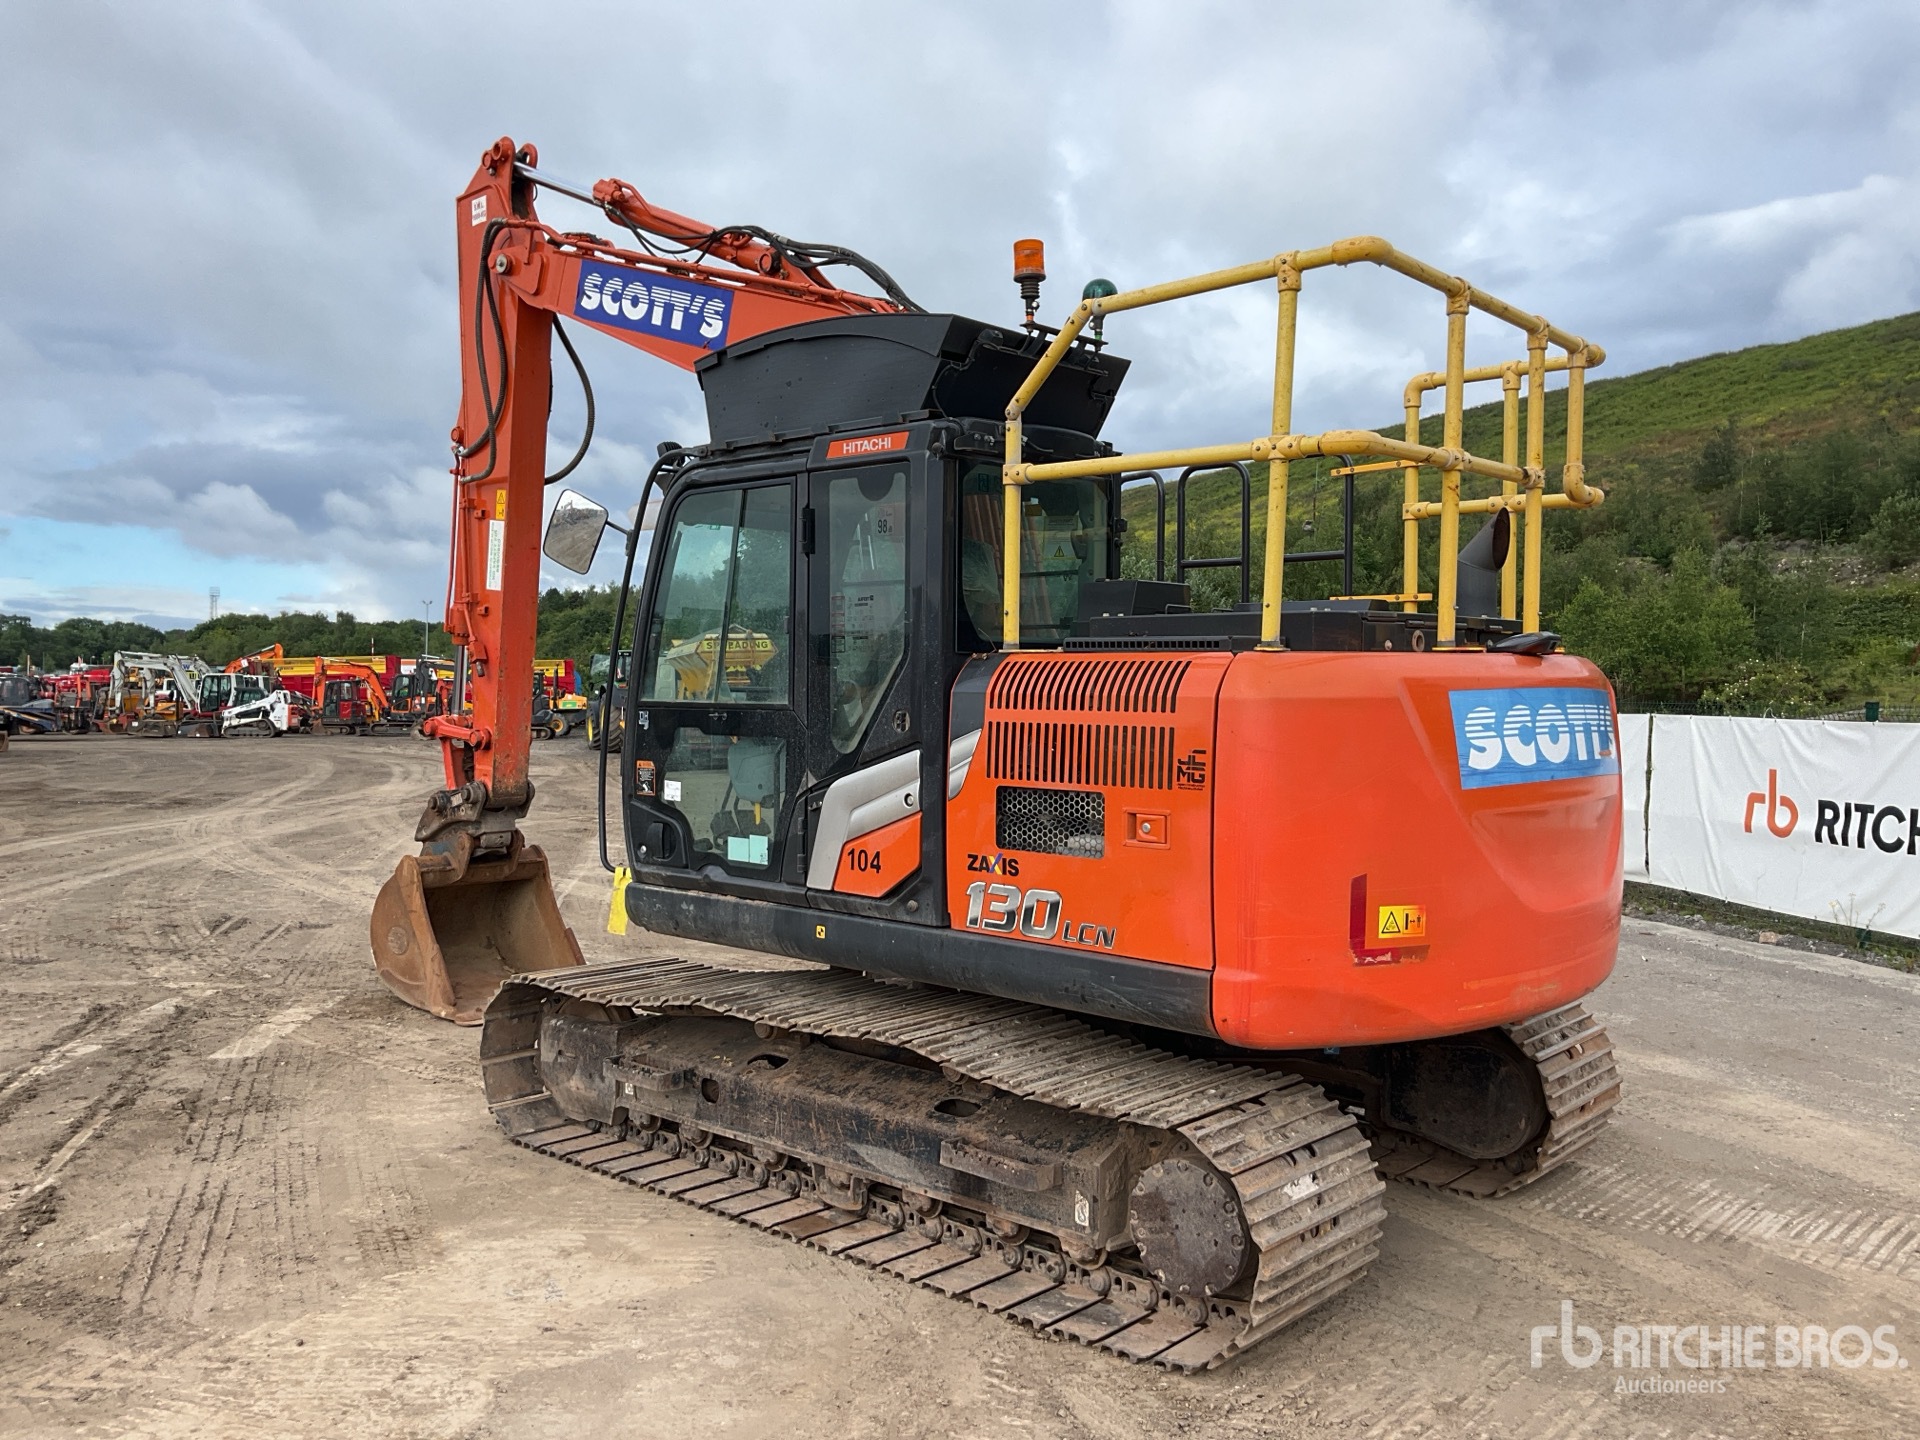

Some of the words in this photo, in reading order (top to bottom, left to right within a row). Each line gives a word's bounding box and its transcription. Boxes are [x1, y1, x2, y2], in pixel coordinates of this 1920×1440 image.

[580, 271, 726, 339] SCOTT'S
[842, 435, 892, 457] HITACHI
[877, 518, 888, 534] 98
[706, 641, 768, 650] SPEADING
[1744, 767, 1799, 839] rb
[847, 849, 882, 874] 104
[966, 852, 1020, 877] ZAXIS
[965, 880, 1064, 941] 130
[1061, 920, 1117, 950] LCN
